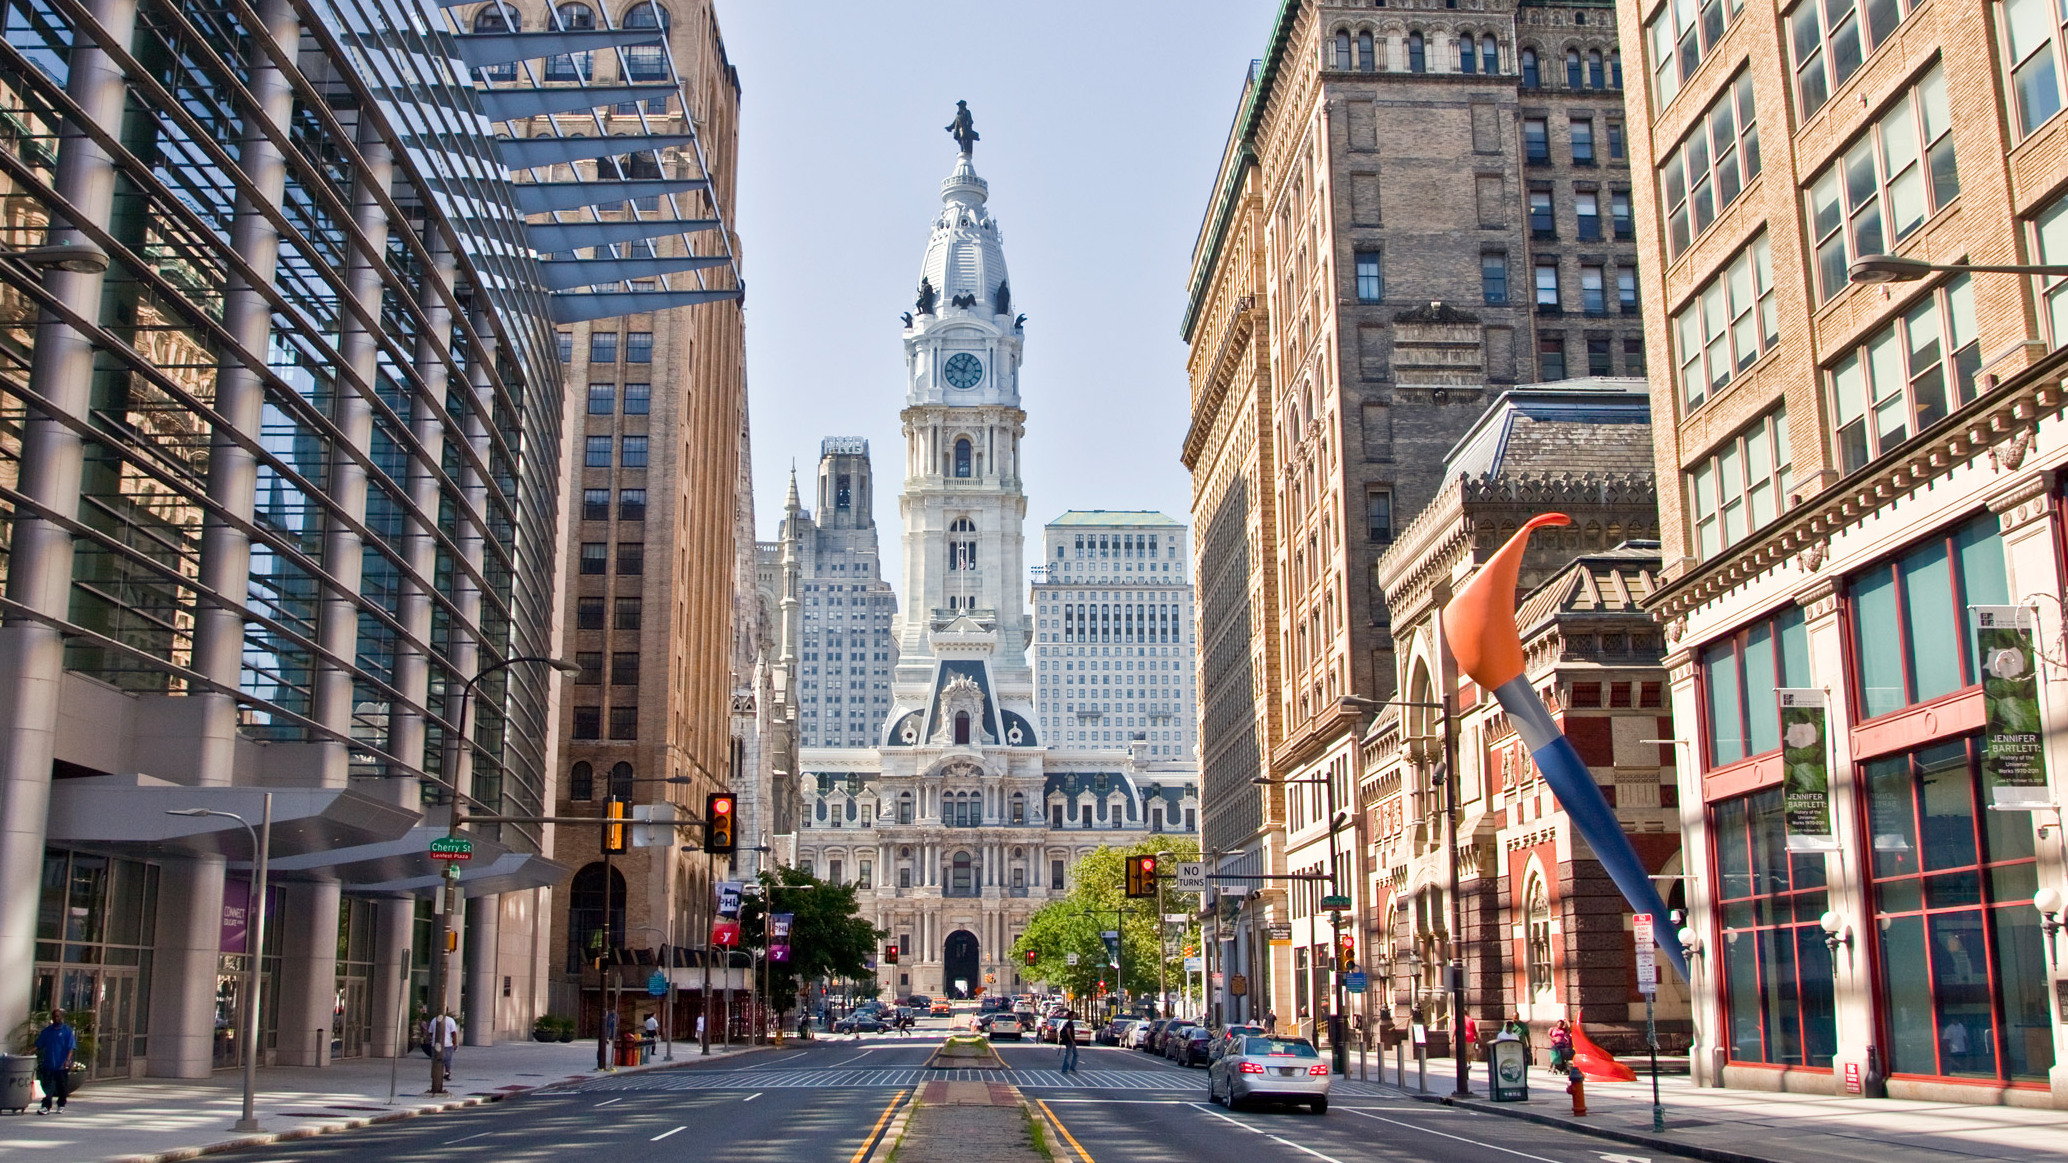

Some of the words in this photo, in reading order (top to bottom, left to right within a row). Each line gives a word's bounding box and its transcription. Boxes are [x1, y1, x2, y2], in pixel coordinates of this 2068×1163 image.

[824, 435, 864, 455] PNB
[1991, 734, 2036, 743] JENNIFER
[1992, 744, 2042, 753] BARTLETT:
[1787, 793, 1823, 801] JENNIFER
[431, 843, 460, 853] Cherry
[462, 844, 471, 852] St
[1183, 866, 1199, 876] NO
[1179, 878, 1204, 887] TURNS
[224, 905, 246, 918] CONNECT
